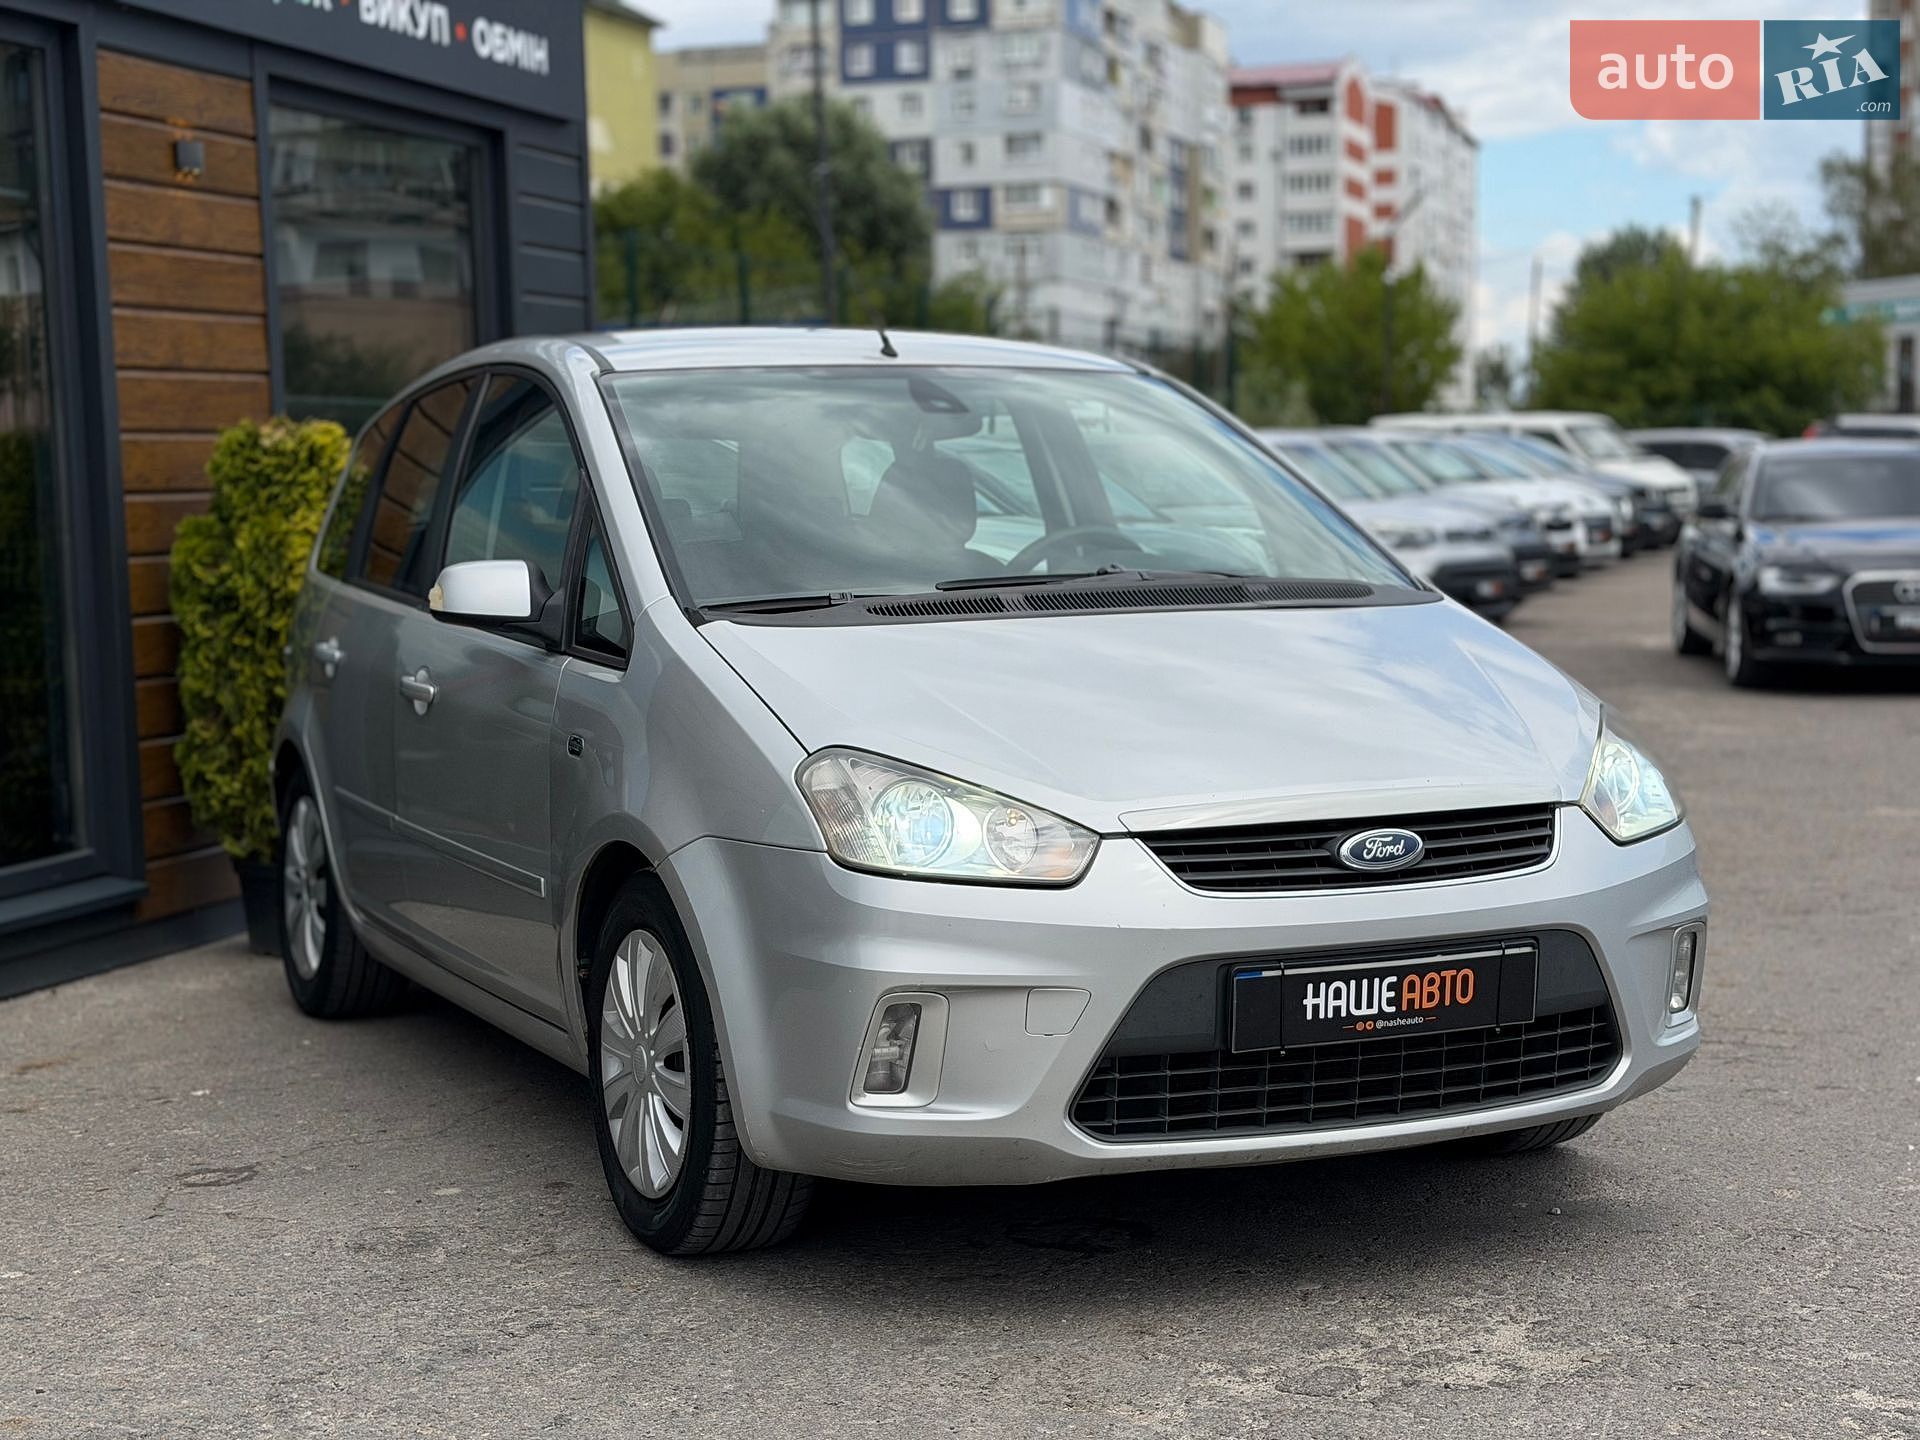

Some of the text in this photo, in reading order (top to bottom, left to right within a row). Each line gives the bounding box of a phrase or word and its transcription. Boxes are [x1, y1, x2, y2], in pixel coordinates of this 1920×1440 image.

[358, 0, 549, 75] ВИКУП ОБМІН
[1363, 836, 1406, 860] Ford
[1303, 968, 1474, 1020] НАШЕ АВТО
[1376, 1016, 1424, 1029] @nasheauto
